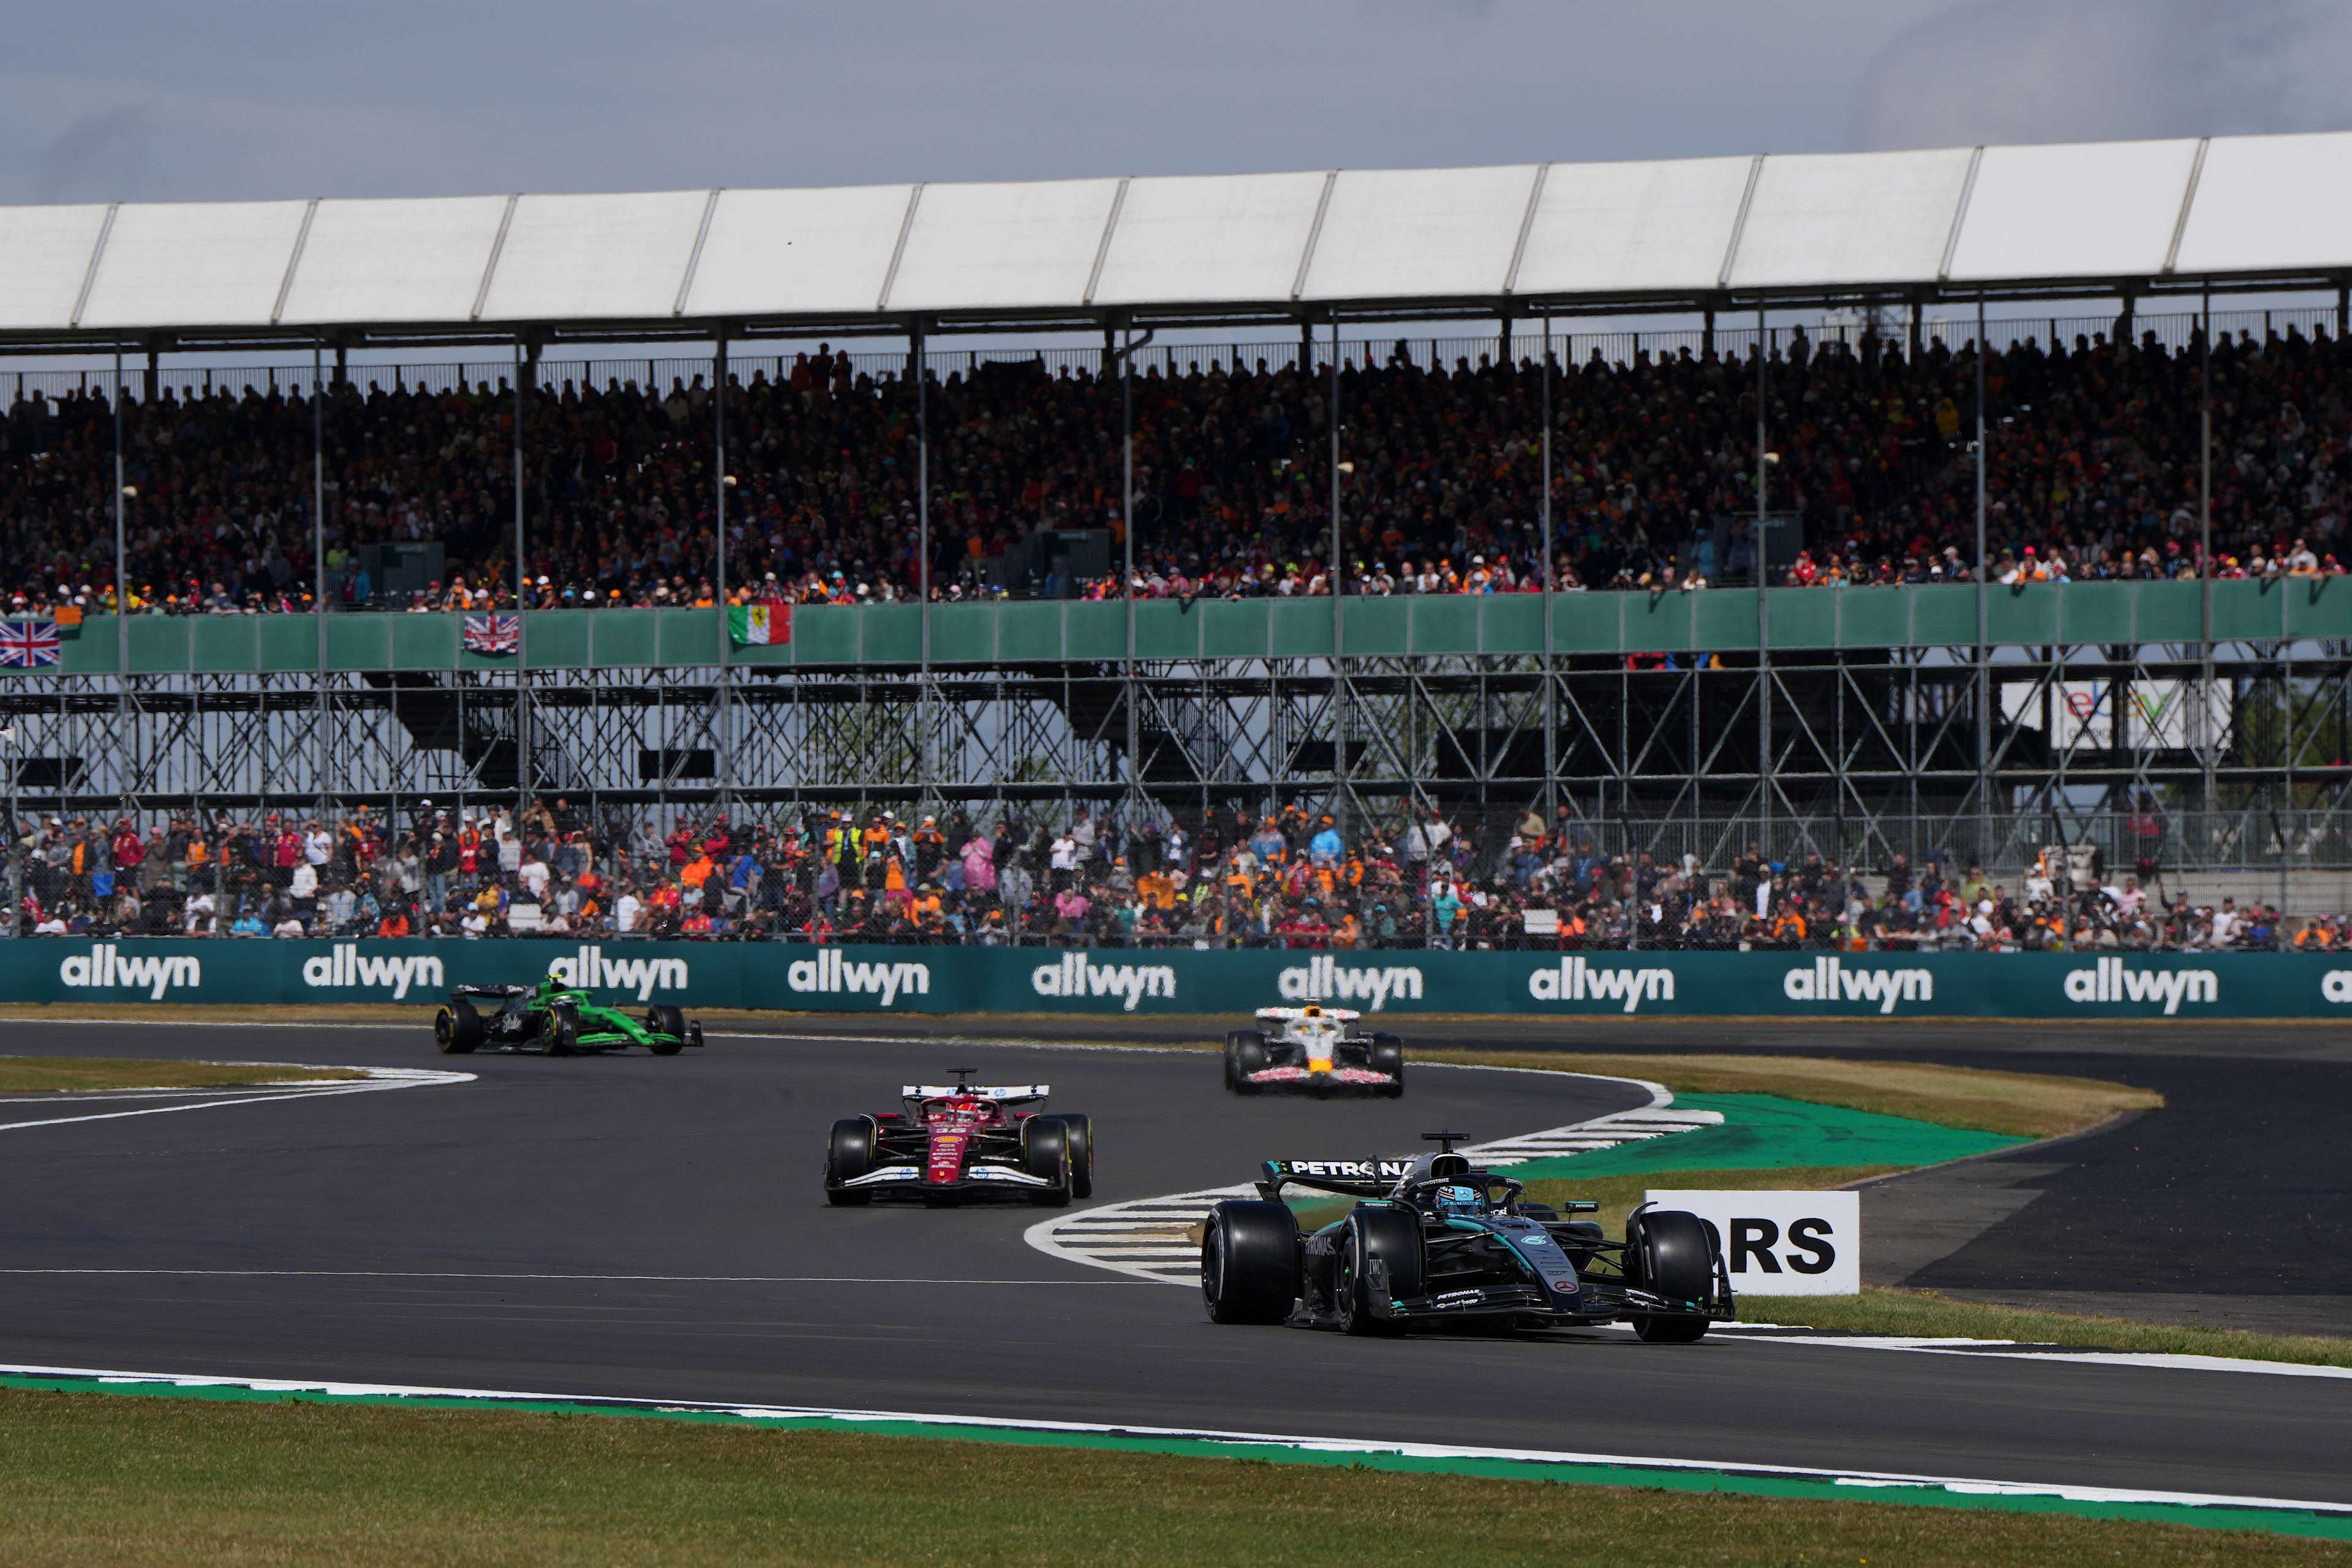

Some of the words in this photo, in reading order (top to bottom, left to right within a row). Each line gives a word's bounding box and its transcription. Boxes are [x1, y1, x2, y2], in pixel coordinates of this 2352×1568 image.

[61, 944, 200, 1001] allwyn
[304, 944, 443, 1001] allwyn
[549, 946, 687, 1002] allwyn
[789, 949, 930, 1006] allwyn
[1033, 952, 1176, 1011] allwyn
[1278, 956, 1422, 1012] allwyn
[1530, 957, 1673, 1013] allwyn
[1784, 957, 1931, 1014] allwyn
[2065, 957, 2217, 1015] allwyn
[1368, 1259, 1382, 1275] IWC
[1436, 1289, 1481, 1300] PETRONAS
